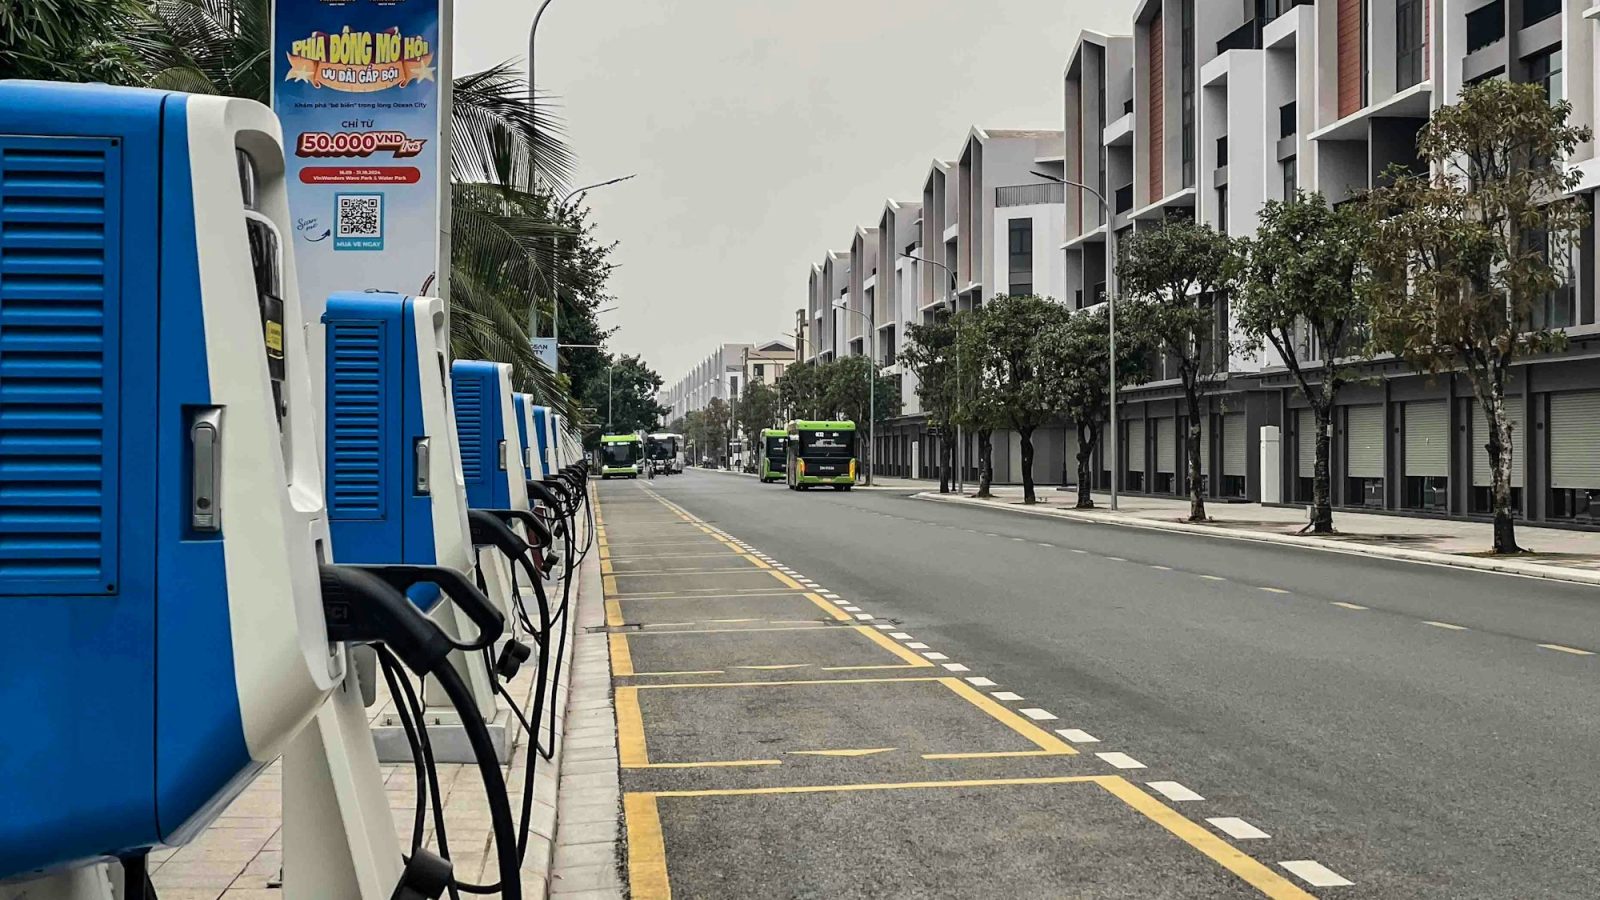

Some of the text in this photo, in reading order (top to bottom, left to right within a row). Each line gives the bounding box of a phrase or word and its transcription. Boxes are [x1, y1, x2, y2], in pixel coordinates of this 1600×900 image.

[292, 25, 429, 66] PHÍA ĐÔNG MỞ HỘI
[322, 65, 398, 83] ƯU ĐÃI GẤP BỘI
[341, 118, 374, 128] CHỈ TỪ
